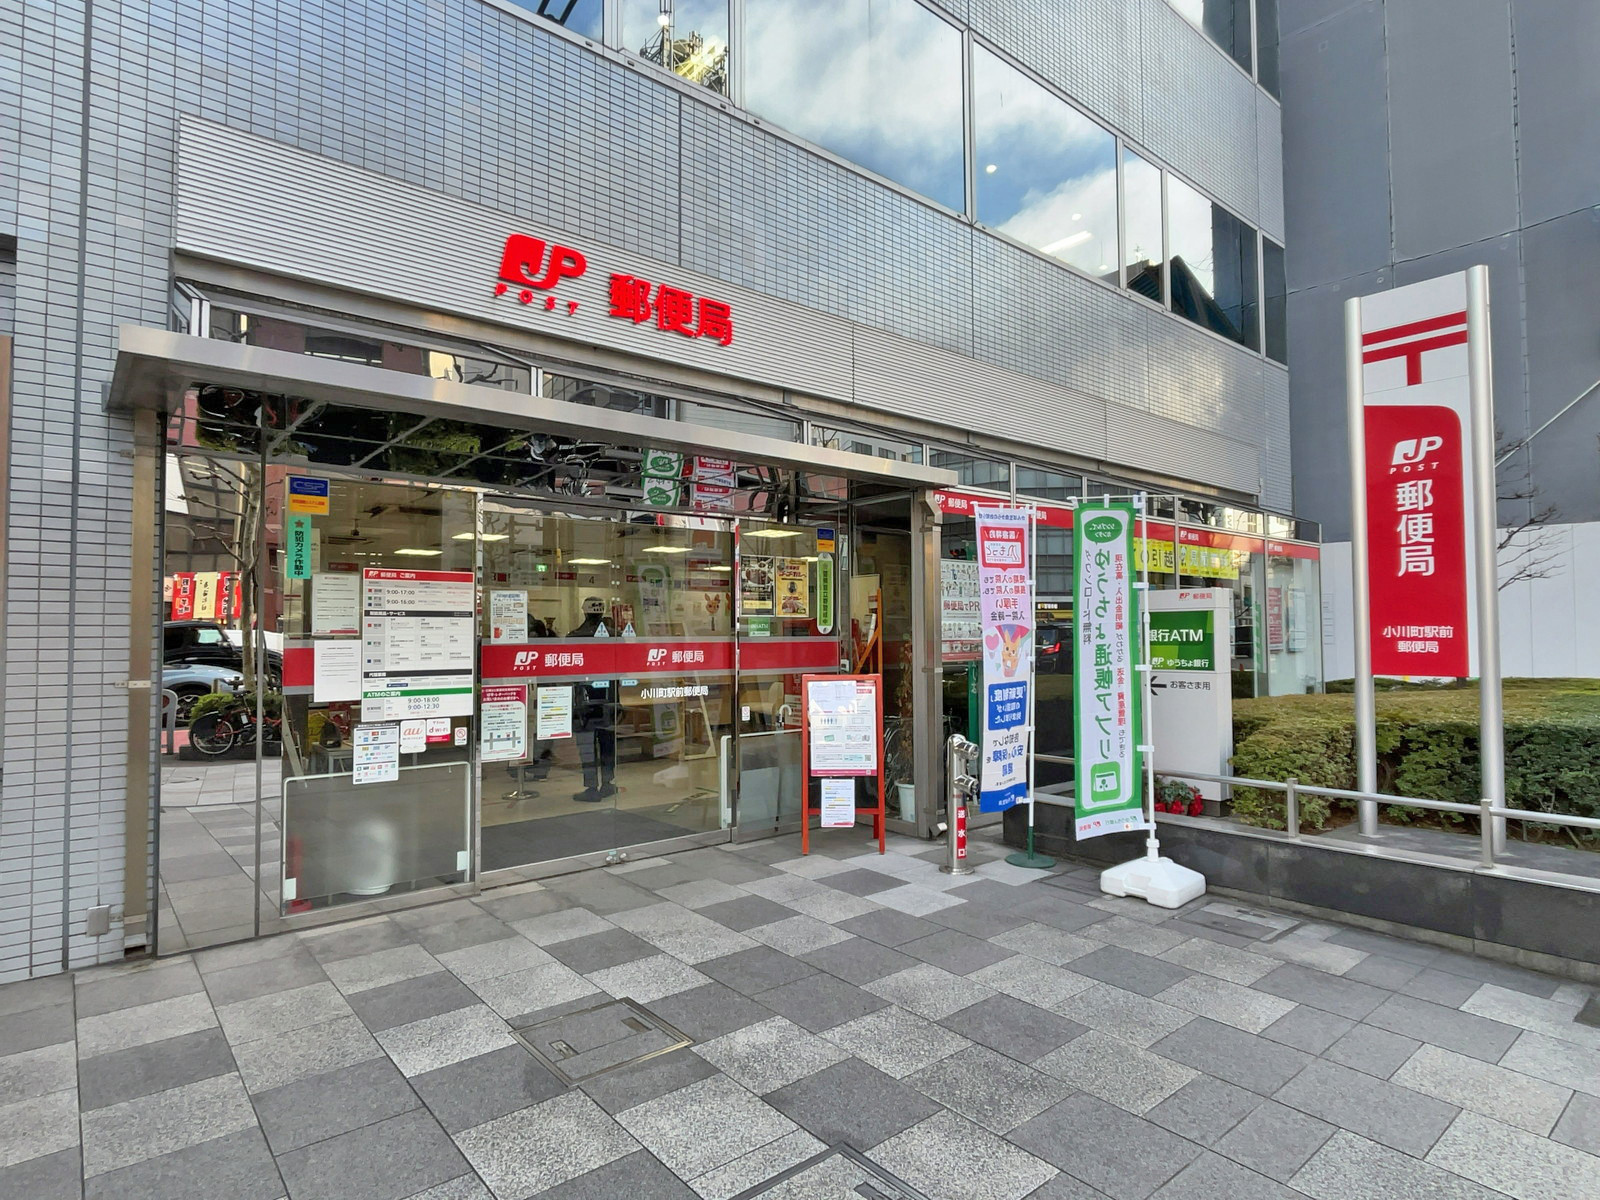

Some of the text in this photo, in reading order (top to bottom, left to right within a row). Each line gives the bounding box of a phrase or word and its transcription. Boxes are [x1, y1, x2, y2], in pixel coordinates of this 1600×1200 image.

[494, 282, 579, 316] POST
[608, 272, 733, 346] 郵便局
[1389, 461, 1439, 475] POST
[948, 498, 968, 510] 郵便局
[1395, 478, 1435, 578] 郵便局
[294, 530, 304, 577] 防犯カメラ作動中
[1192, 592, 1212, 600] 郵便局
[1382, 625, 1454, 639] 小川町駅前
[1396, 640, 1440, 654] 郵便局
[544, 652, 584, 667] 郵便局
[671, 650, 705, 664] 郵便局
[1167, 658, 1210, 668] ゆうちょ銀行
[640, 685, 709, 699] 小川町駅前郵便局
[1169, 680, 1211, 691] お客さま用
[403, 727, 423, 736] au
[957, 809, 966, 857] 送水口
